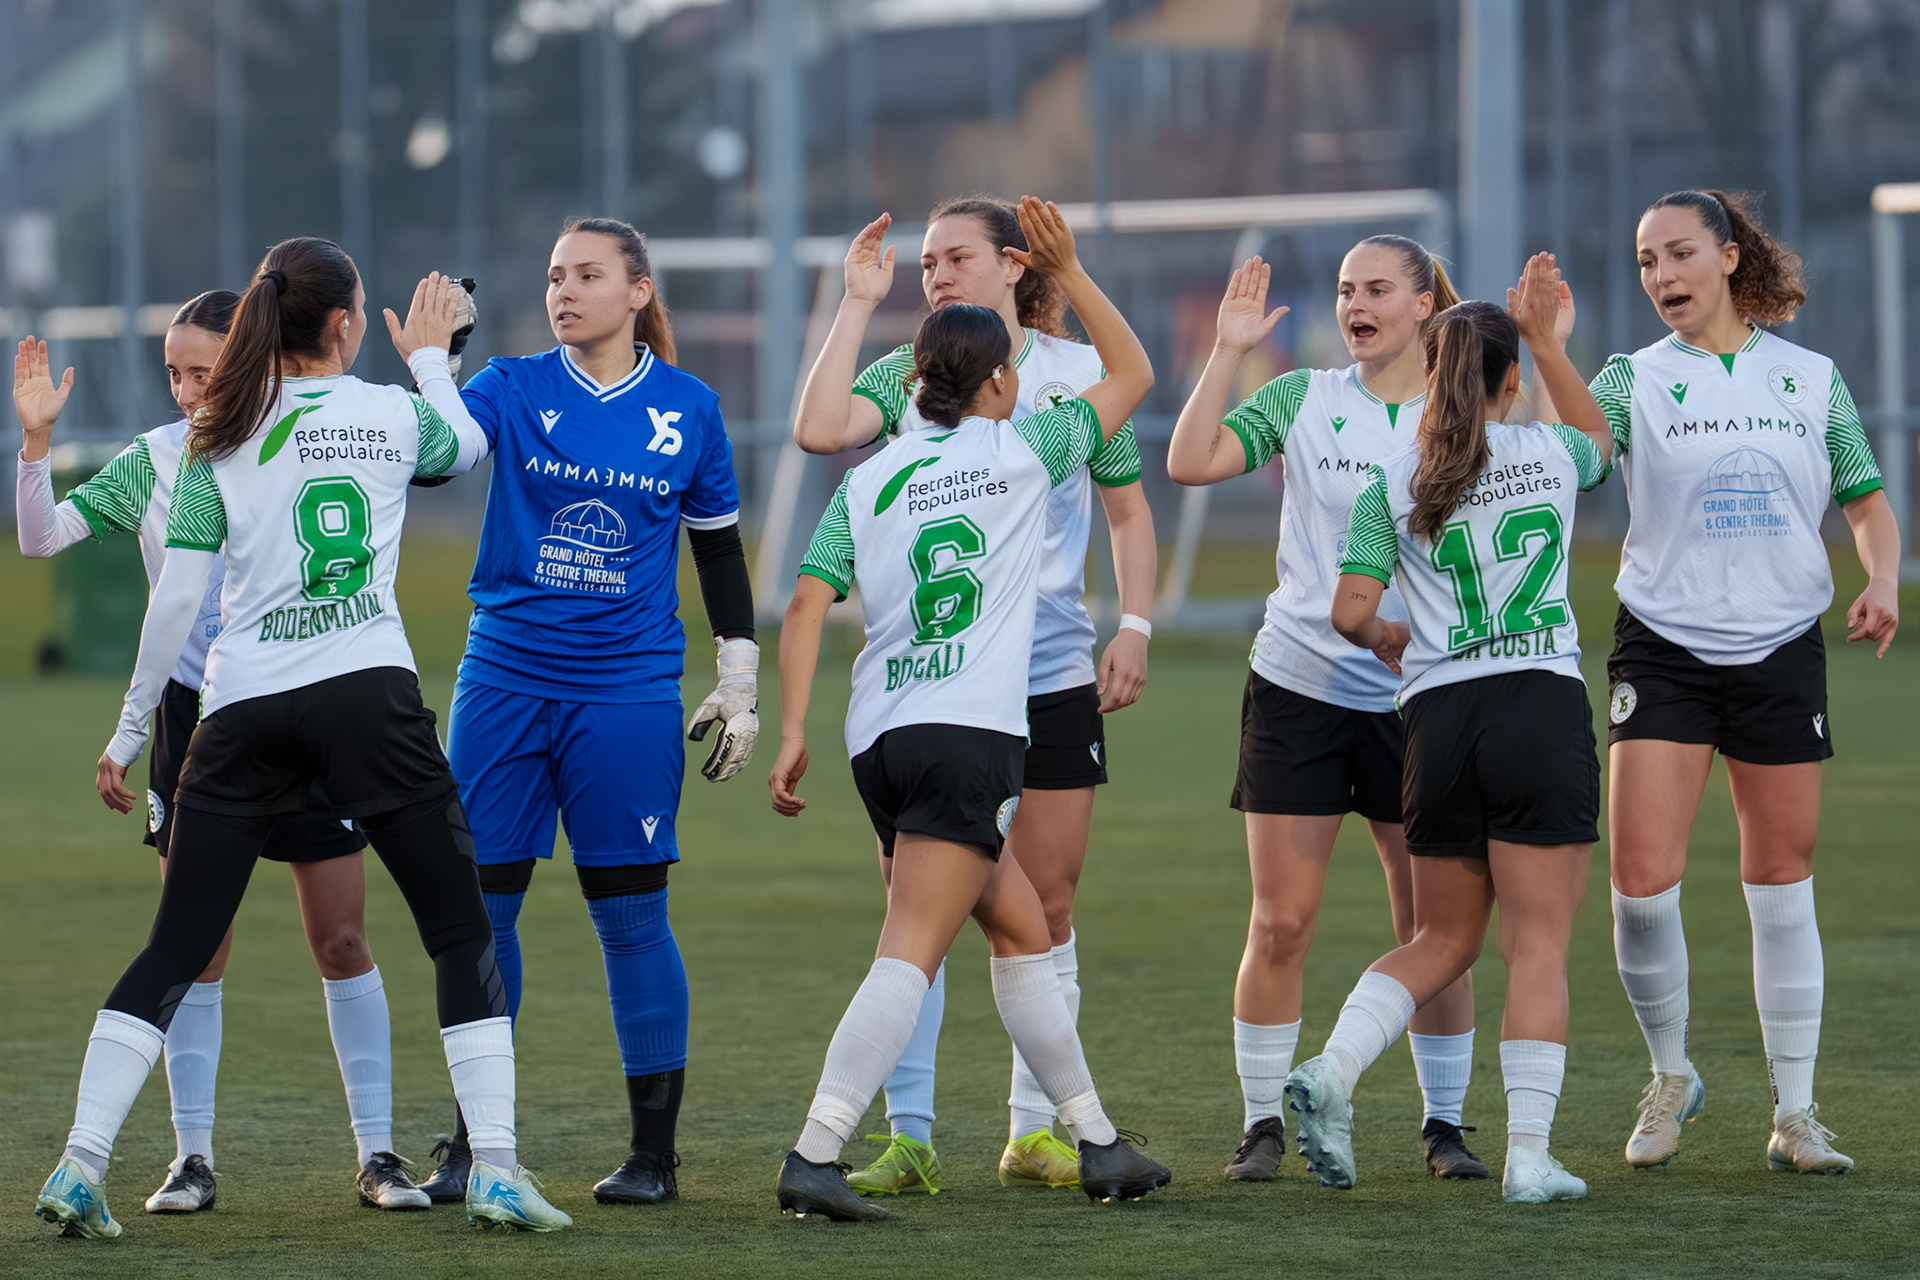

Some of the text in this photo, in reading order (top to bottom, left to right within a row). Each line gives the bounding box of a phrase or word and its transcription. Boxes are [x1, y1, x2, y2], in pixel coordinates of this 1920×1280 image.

[295, 426, 387, 446] Retraites
[299, 443, 402, 463] Populaires
[1318, 456, 1370, 473] AMM
[908, 468, 990, 498] Retraites
[1467, 461, 1544, 489] traites
[909, 481, 1008, 515] Populaires
[1457, 477, 1561, 509] Populaires
[1703, 496, 1768, 514] GRAND HÔTEL
[1705, 513, 1791, 530] & CENTRE THERMAL
[293, 475, 376, 601] 8
[540, 544, 605, 568] GRAND HÔTEL
[534, 575, 627, 594] YVERDON-LES-BAINS
[535, 561, 626, 585] & CENTRE THERMAL
[908, 514, 986, 647] 6
[1430, 503, 1569, 651] 12
[258, 588, 386, 643] BODENMANN
[884, 642, 965, 693] BOGALI
